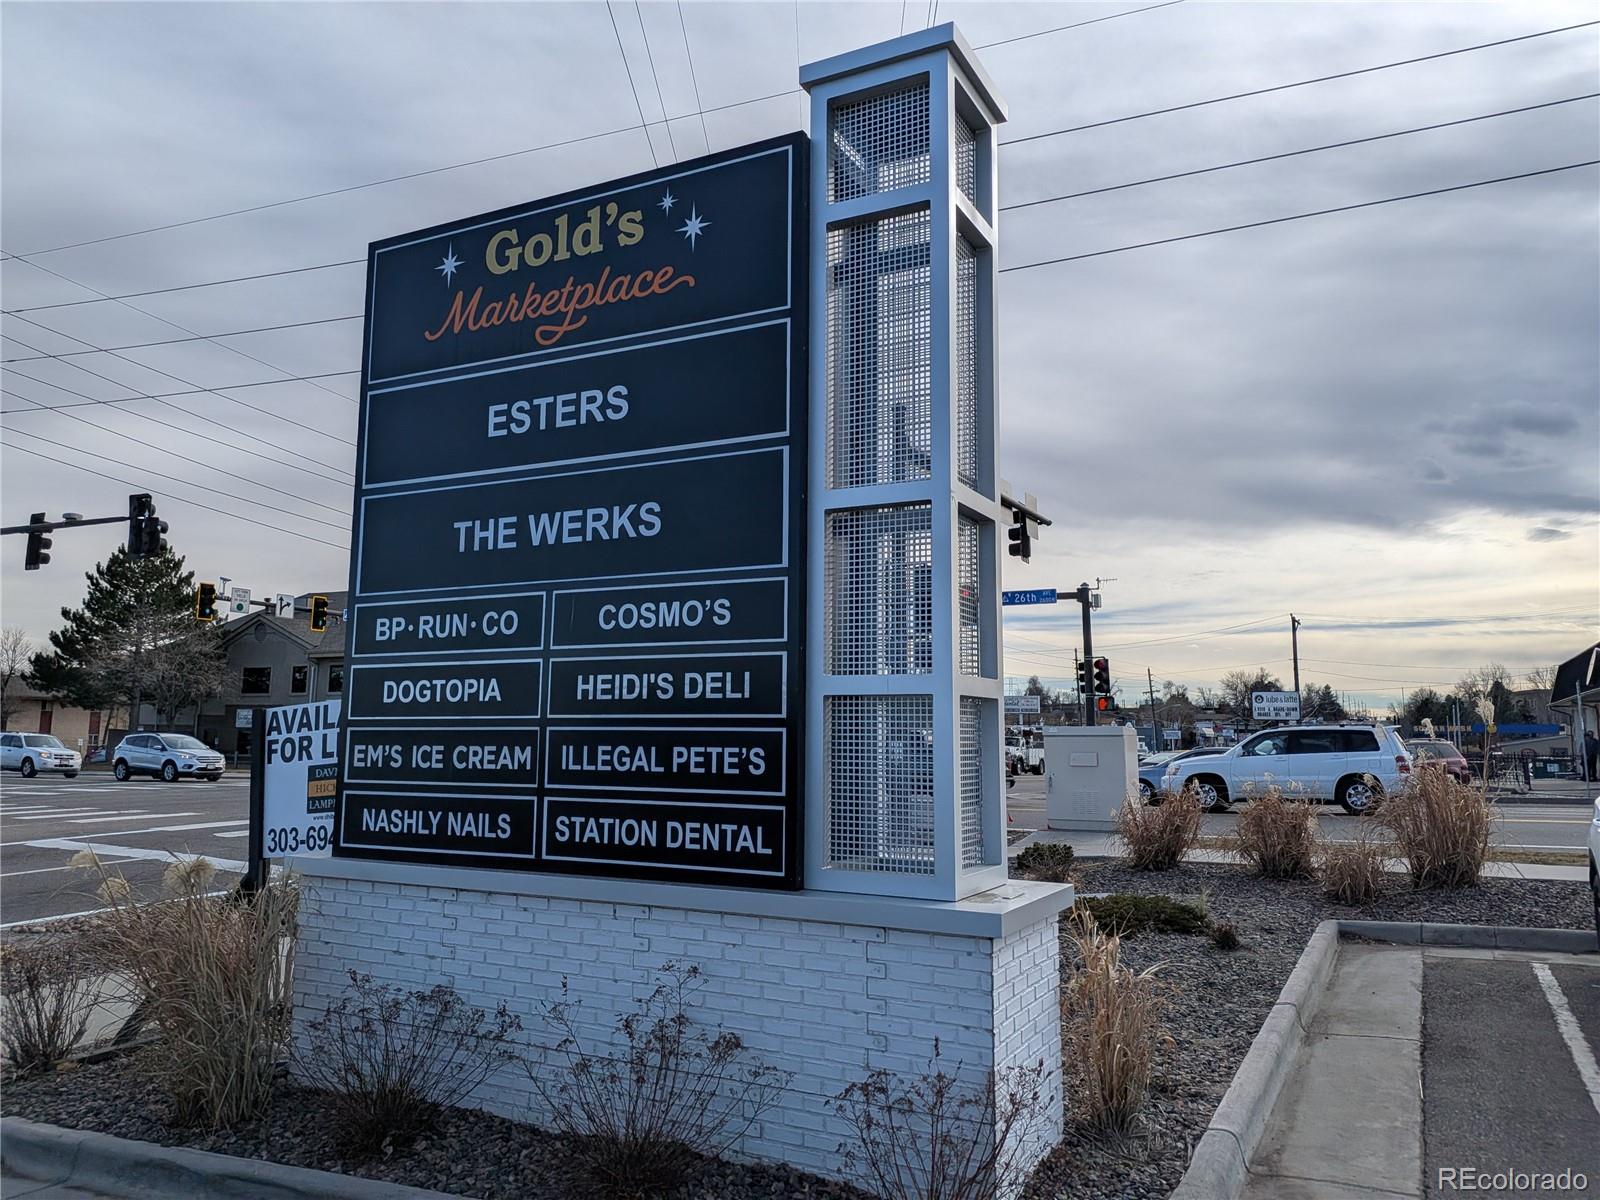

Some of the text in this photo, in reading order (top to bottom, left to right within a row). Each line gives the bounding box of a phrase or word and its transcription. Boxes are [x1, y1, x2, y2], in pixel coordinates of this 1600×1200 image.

[485, 201, 644, 276] Gold’s
[424, 265, 695, 346] Marketplace
[487, 384, 629, 438] ESTERS
[453, 501, 662, 553] THE WERKS
[598, 598, 731, 630] COSMO’S
[1014, 593, 1037, 603] 26th
[383, 678, 502, 703] DOGTOPIA
[576, 671, 750, 700] HEIDI'S DELI
[266, 704, 341, 736] AVAIL
[267, 733, 339, 765] FOR L
[353, 744, 532, 770] EM’S ICE CREAM
[561, 744, 766, 776] ILLEGAL PETE’S
[315, 767, 338, 778] DAVI
[362, 808, 511, 839] NASHLY NAILS
[555, 815, 773, 855] STATION DENTAL
